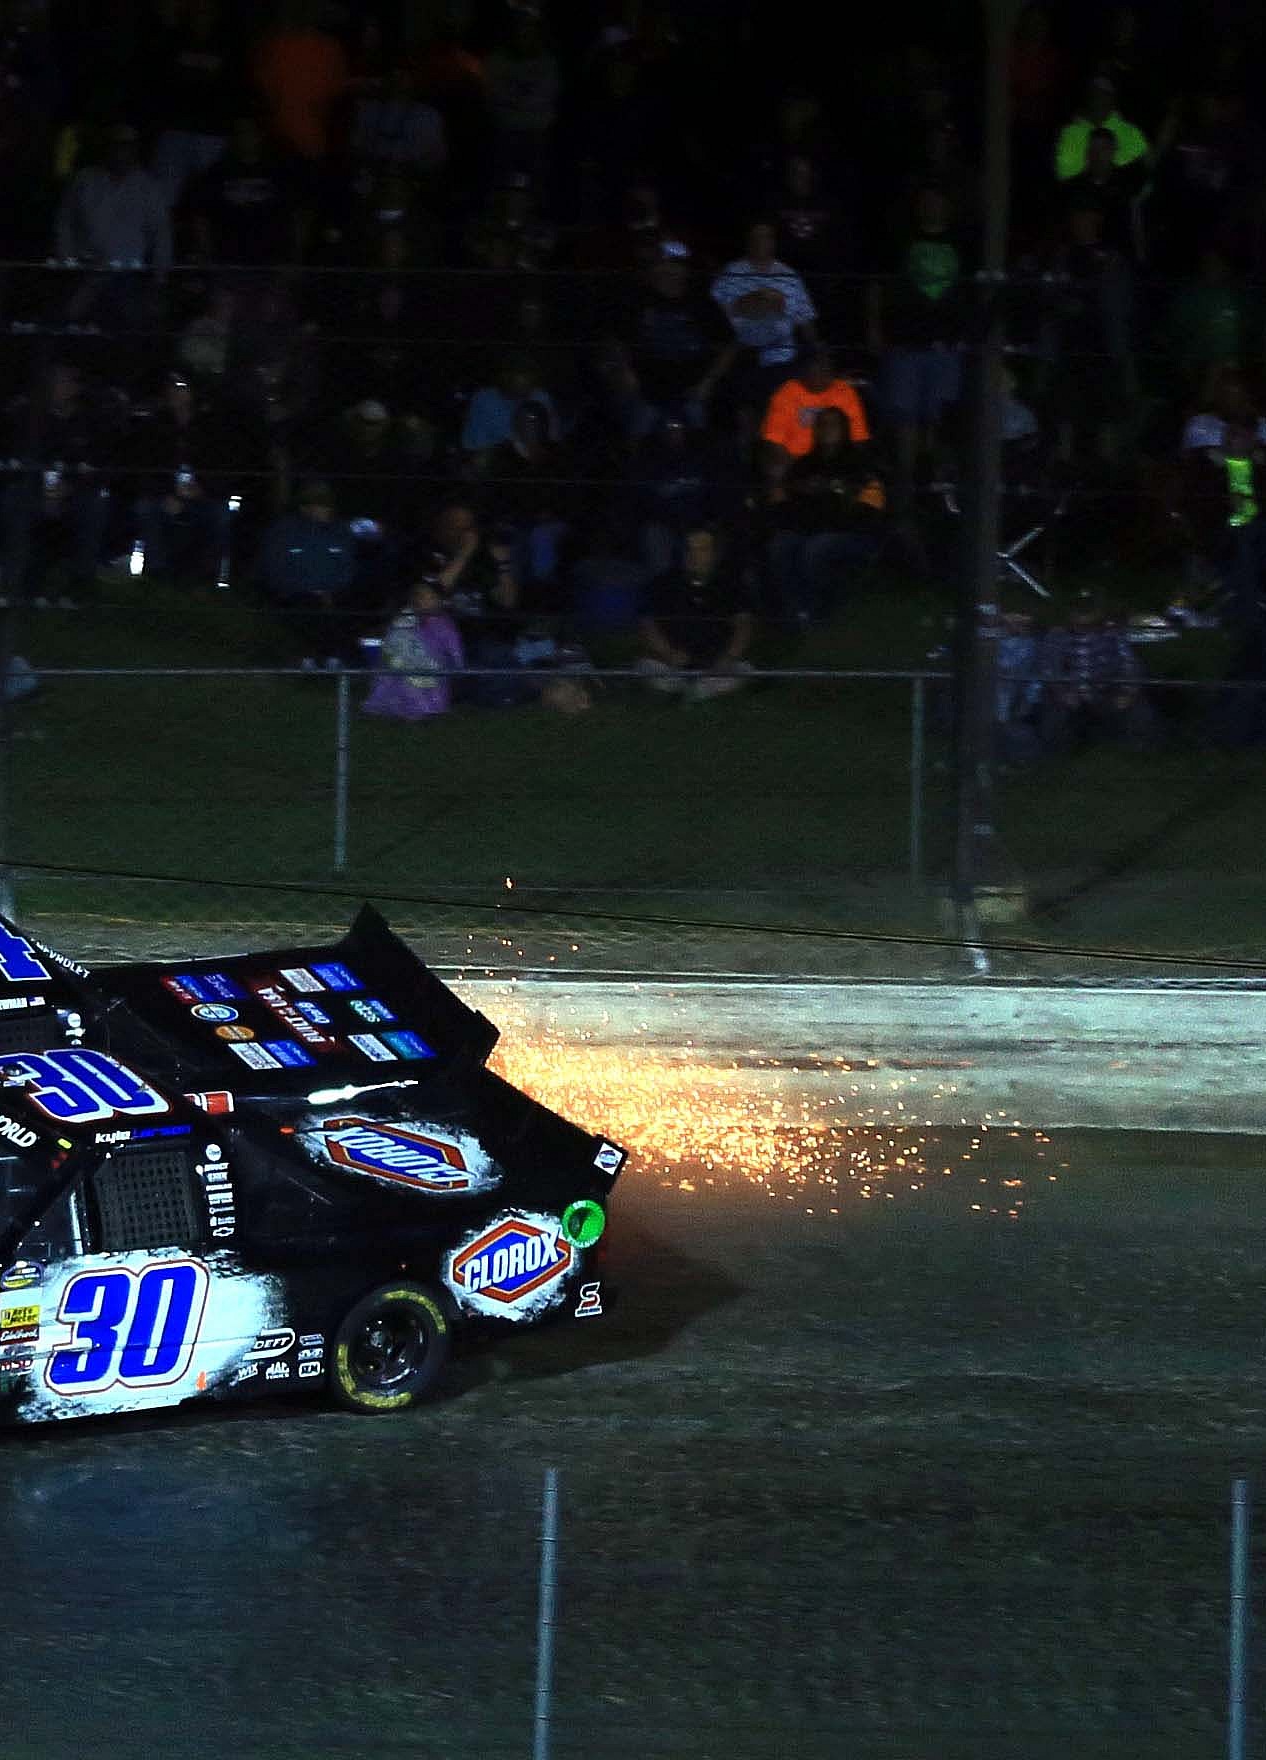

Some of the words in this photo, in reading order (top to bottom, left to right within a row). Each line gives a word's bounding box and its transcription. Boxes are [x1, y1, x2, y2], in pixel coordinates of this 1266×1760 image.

[310, 1126, 476, 1183] CLOROX
[464, 1229, 561, 1295] CLOROX
[45, 1259, 207, 1393] 30
[253, 1337, 290, 1349] DEFT
[238, 1362, 258, 1378] WIX
